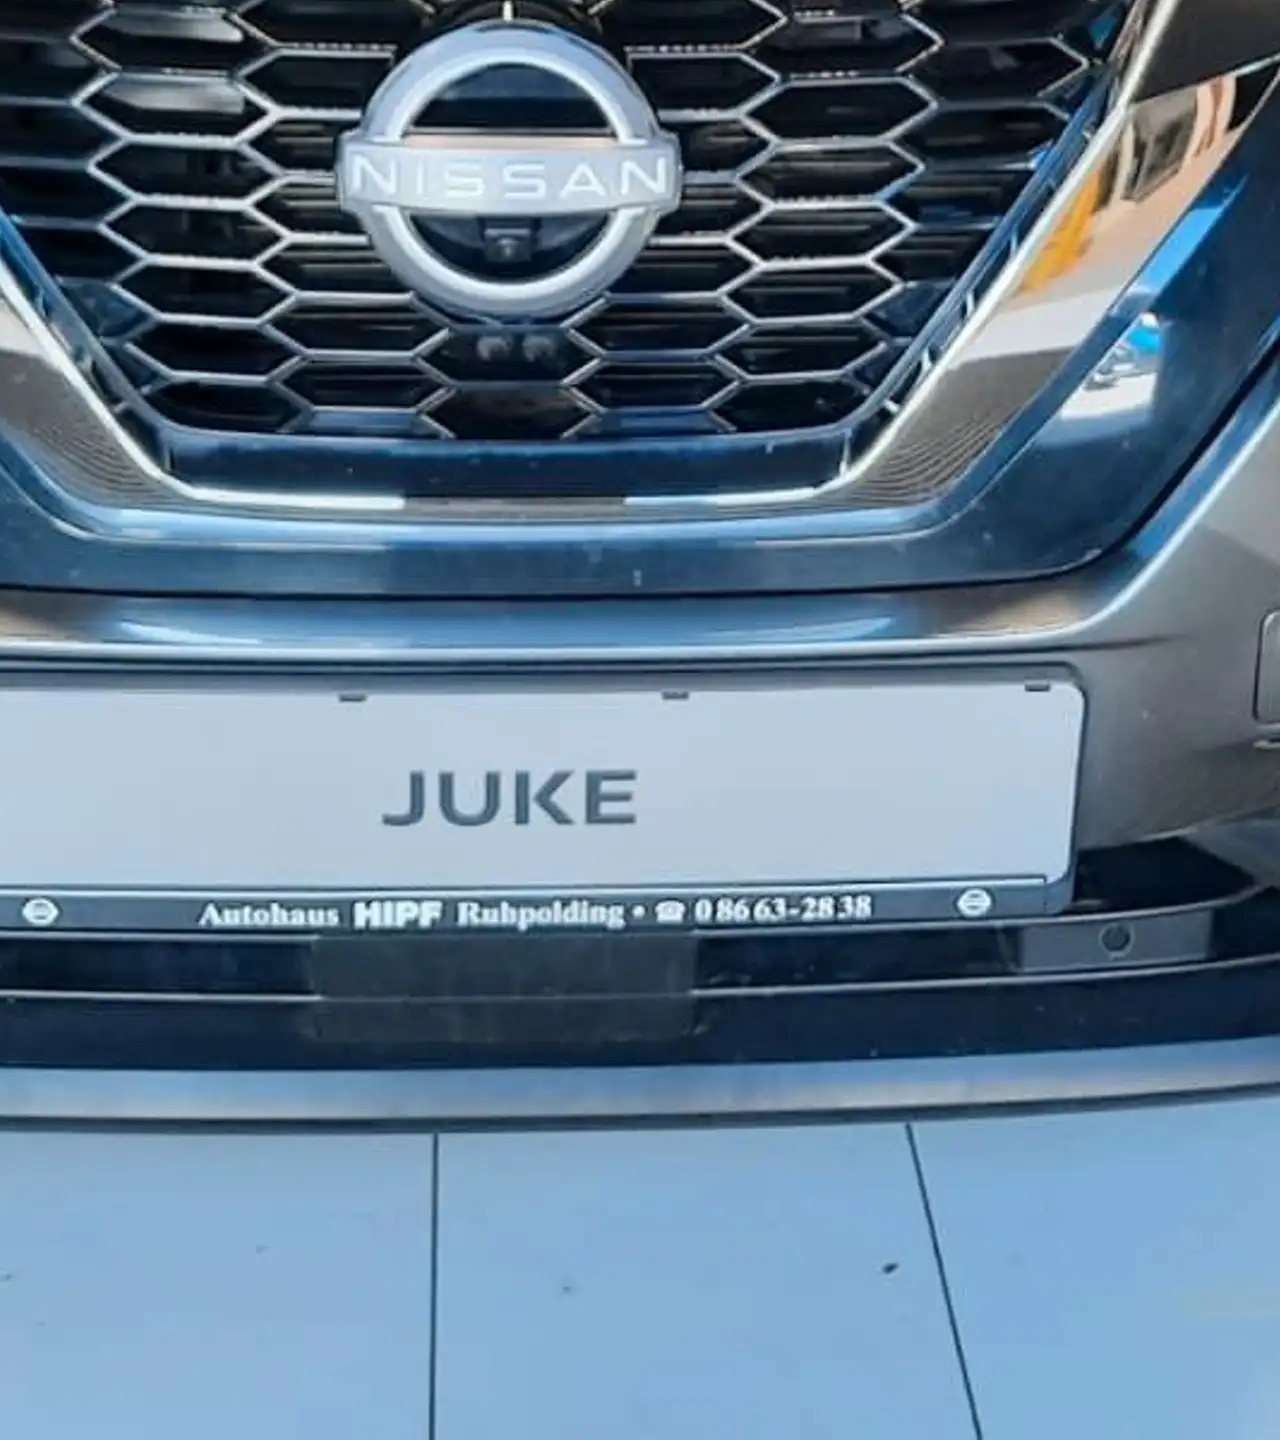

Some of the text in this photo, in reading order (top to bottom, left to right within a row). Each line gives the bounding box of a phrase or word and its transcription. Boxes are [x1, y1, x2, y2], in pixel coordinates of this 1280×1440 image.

[350, 155, 668, 198] NISSAN
[381, 769, 638, 827] JUKE
[198, 901, 340, 928] Autohaus
[352, 900, 442, 930] HIPF
[456, 899, 626, 932] Ruhpolding
